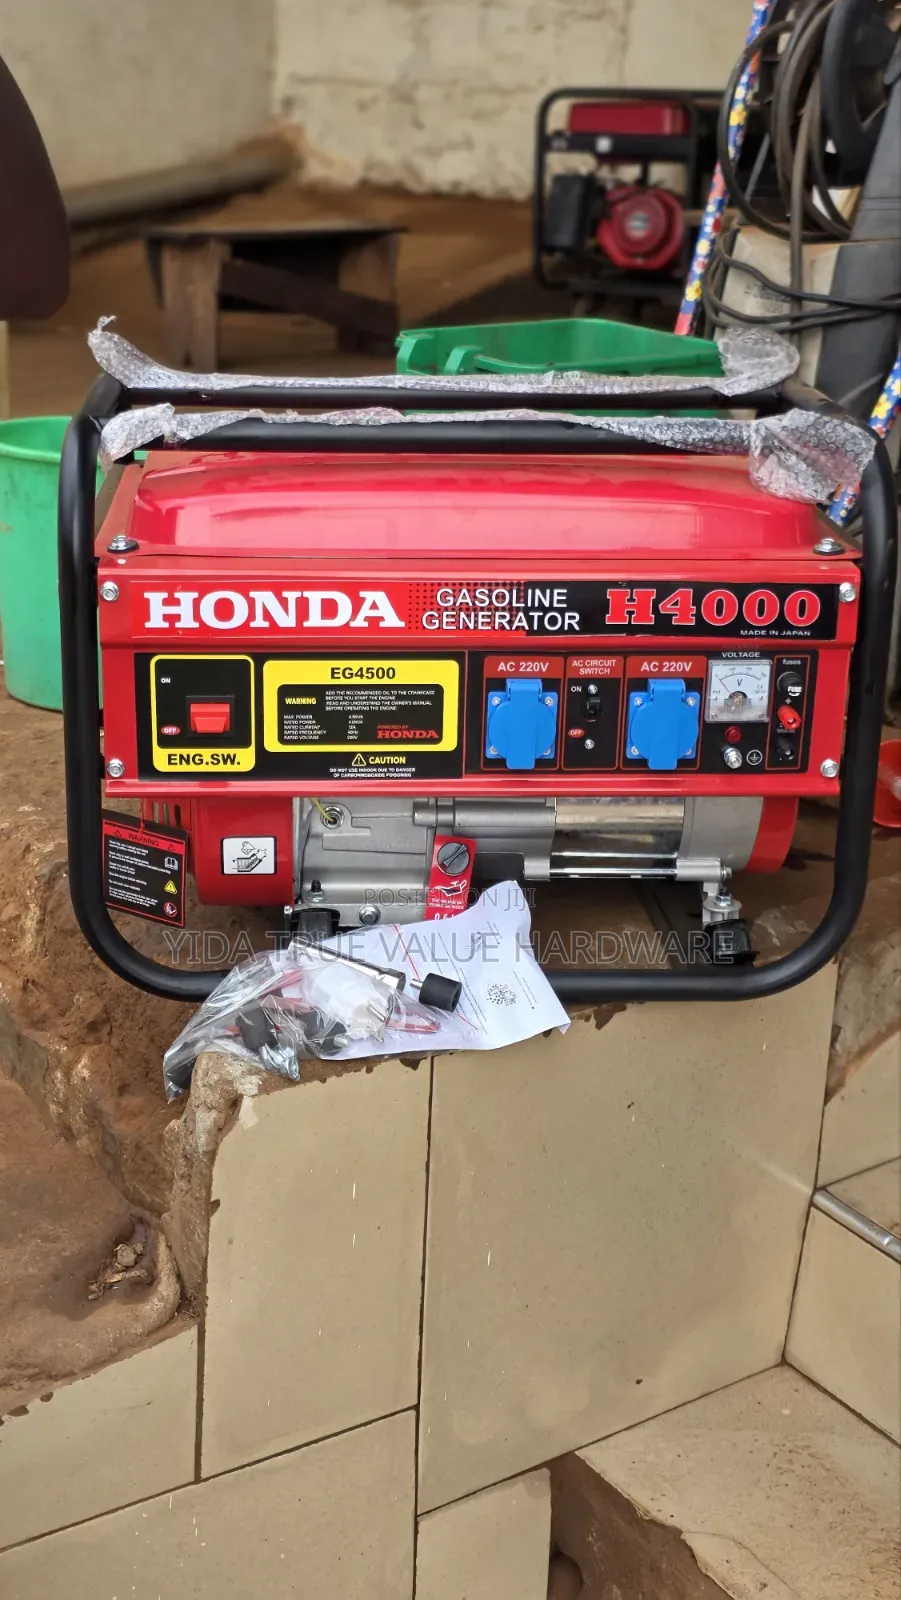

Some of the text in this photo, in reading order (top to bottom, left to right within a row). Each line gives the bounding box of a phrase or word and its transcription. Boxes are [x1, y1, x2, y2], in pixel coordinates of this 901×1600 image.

[436, 588, 568, 608] GASOLINE
[143, 590, 405, 629] HONDA
[605, 588, 821, 627] H4000
[422, 611, 580, 631] GENERATOR
[497, 662, 550, 673] AC 220V
[585, 659, 616, 667] CIRCUIT
[640, 662, 693, 672] AC 220V
[329, 667, 396, 680] EG4500
[285, 697, 317, 705] WARNING
[376, 730, 439, 739] HONDA
[167, 753, 241, 766] ENG.SW.
[368, 756, 406, 764] CAUTION
[127, 832, 160, 847] WARNING
